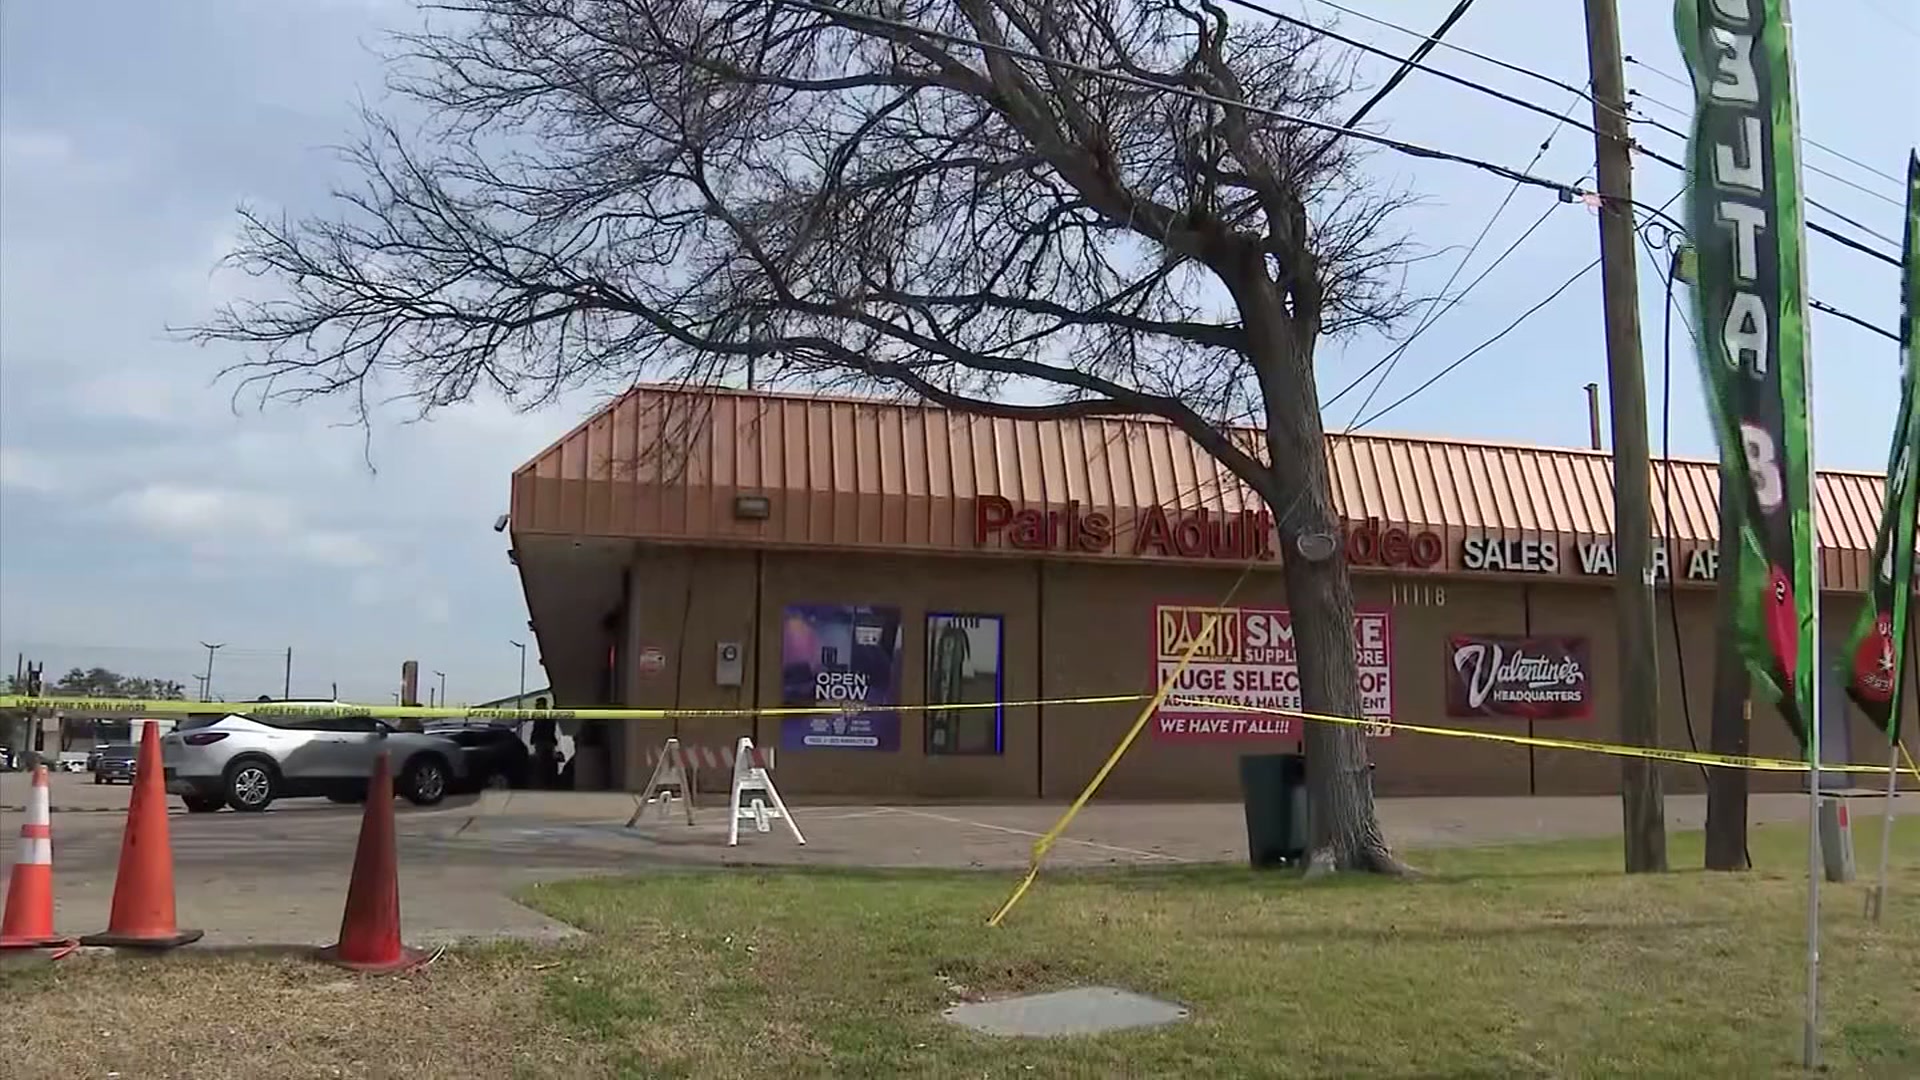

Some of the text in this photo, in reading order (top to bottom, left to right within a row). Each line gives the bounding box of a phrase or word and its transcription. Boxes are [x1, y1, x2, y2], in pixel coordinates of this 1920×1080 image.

[975, 495, 1111, 551] Paris
[1134, 504, 1274, 561] Adult
[1464, 538, 1558, 571] SALES
[1392, 584, 1446, 607] 11118
[1163, 609, 1236, 656] PARIS
[816, 672, 867, 686] OPEN
[1161, 669, 1226, 690] HUGE
[1360, 672, 1387, 693] OF
[815, 685, 869, 700] NOW
[1256, 695, 1290, 709] MALE
[1493, 689, 1582, 703] HEADQUARTERS
[1160, 719, 1186, 733] WE
[1189, 719, 1229, 734] HAVE
[1232, 719, 1248, 734] IT
